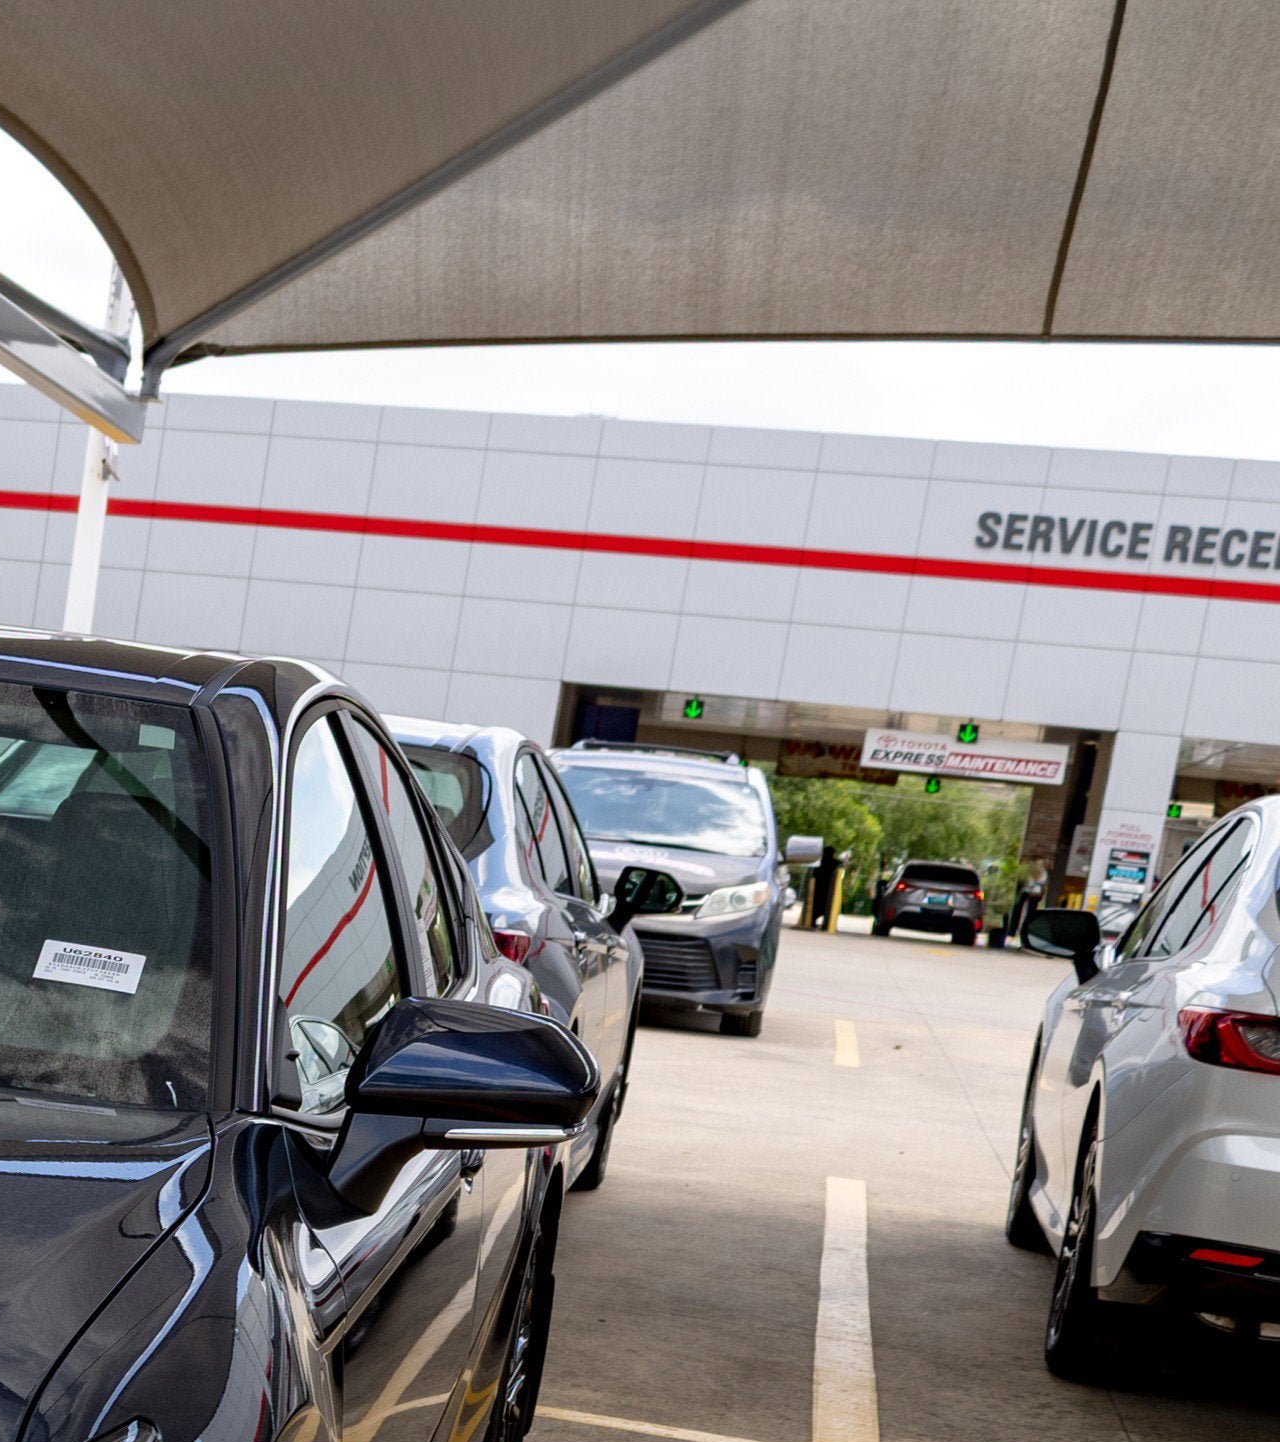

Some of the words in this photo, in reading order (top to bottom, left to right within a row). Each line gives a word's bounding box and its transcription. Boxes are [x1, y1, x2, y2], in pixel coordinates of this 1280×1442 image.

[975, 511, 1153, 560] SERVICE
[1163, 524, 1280, 571] RECE
[899, 738, 947, 751] TOYOTA
[870, 748, 946, 766] EXPRESS
[946, 753, 1059, 777] MAINTENANCE
[63, 947, 123, 962] U62840
